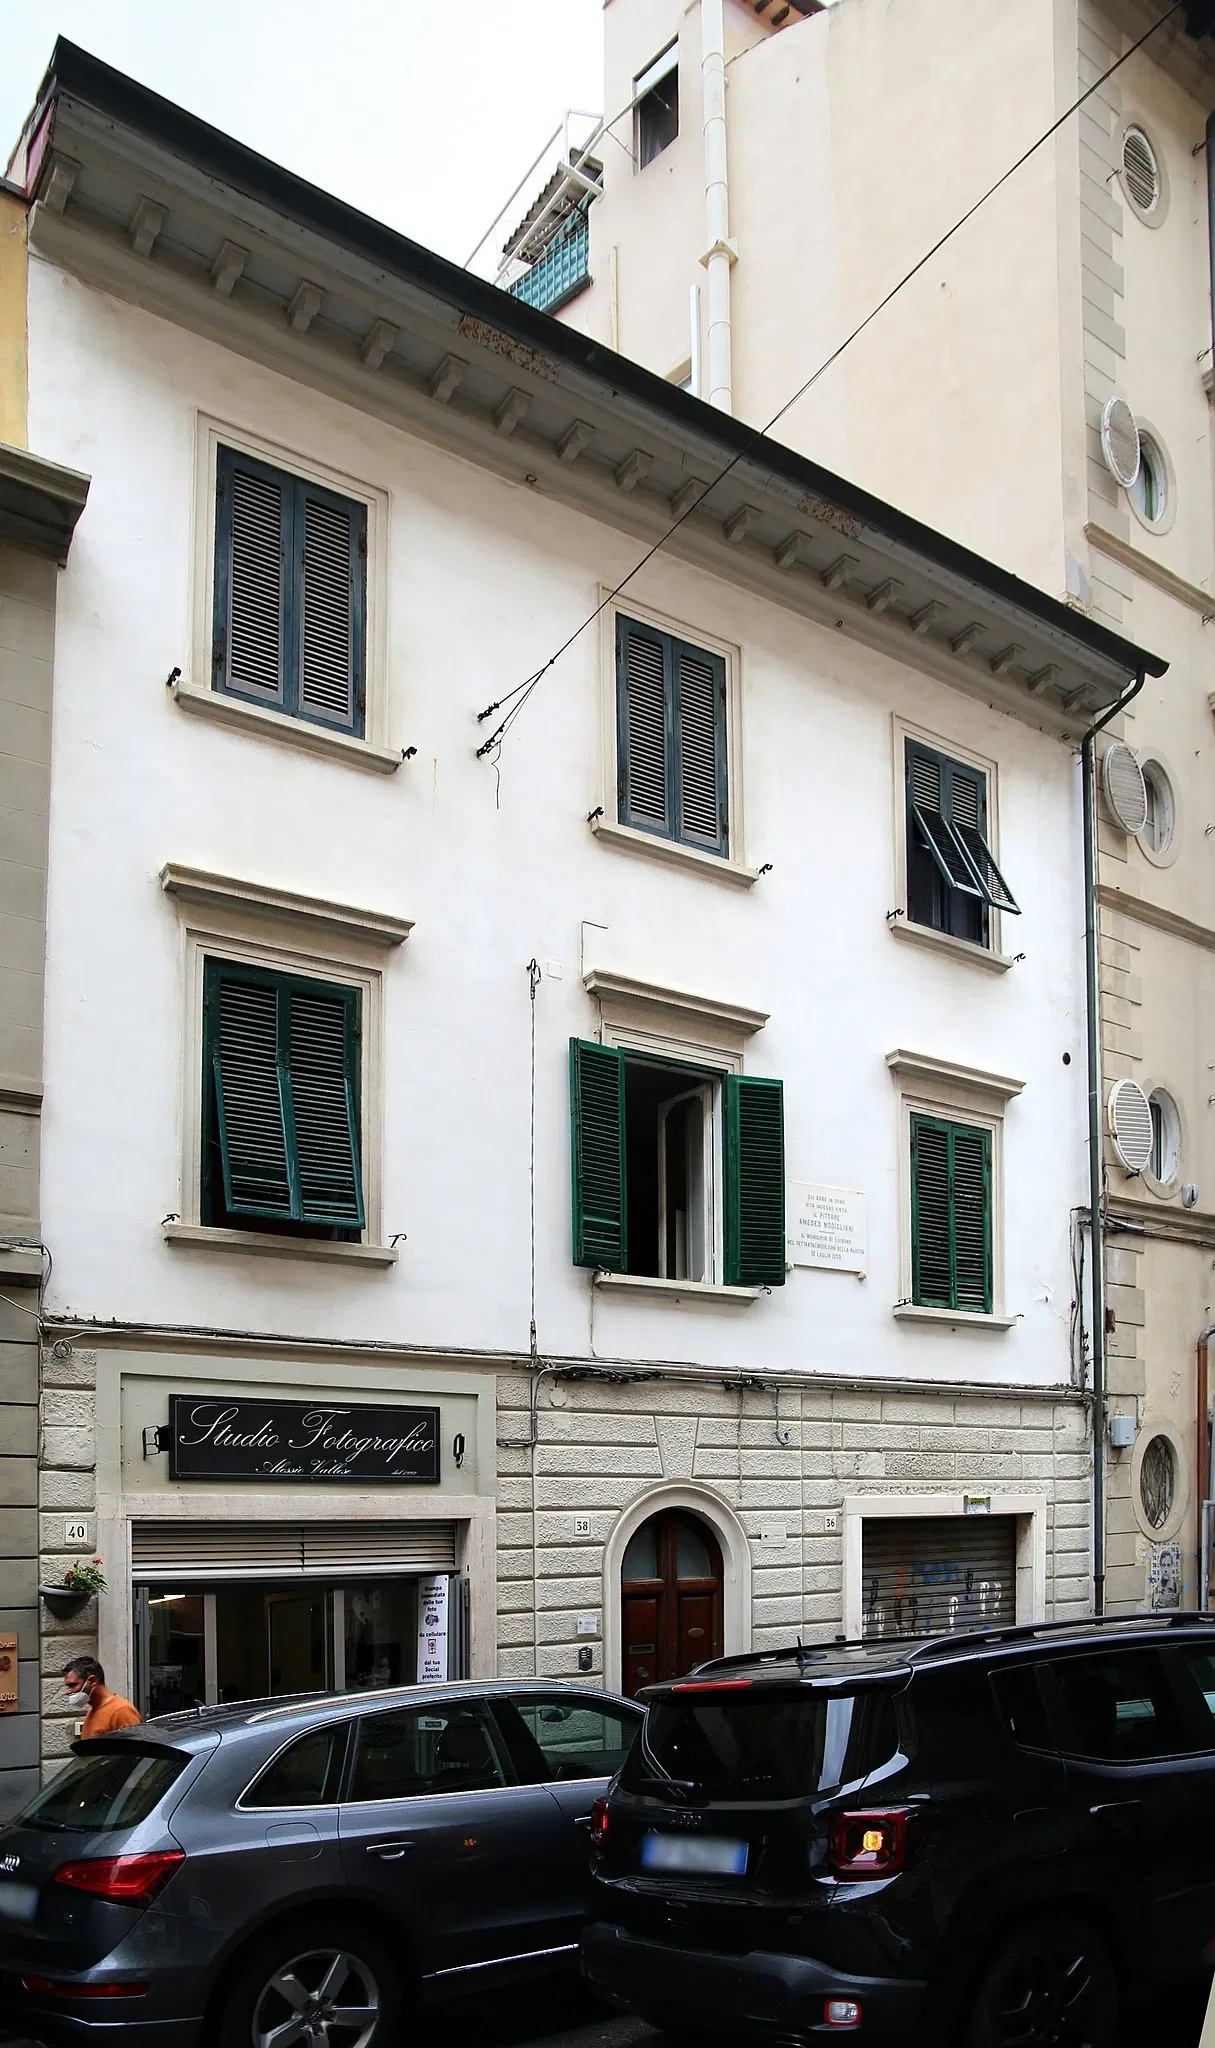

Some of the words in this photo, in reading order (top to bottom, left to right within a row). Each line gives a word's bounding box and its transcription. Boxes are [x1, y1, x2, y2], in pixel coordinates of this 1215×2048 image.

[820, 1212, 840, 1221] PITTORE
[799, 1219, 821, 1227] AMEDEO
[824, 1222, 853, 1232] MODIGLIANI
[180, 1405, 280, 1447] Studio
[288, 1410, 434, 1462] Fotografico
[256, 1459, 304, 1473] Alessio
[577, 1521, 588, 1530] 38
[826, 1518, 834, 1527] 36
[68, 1526, 84, 1538] 40
